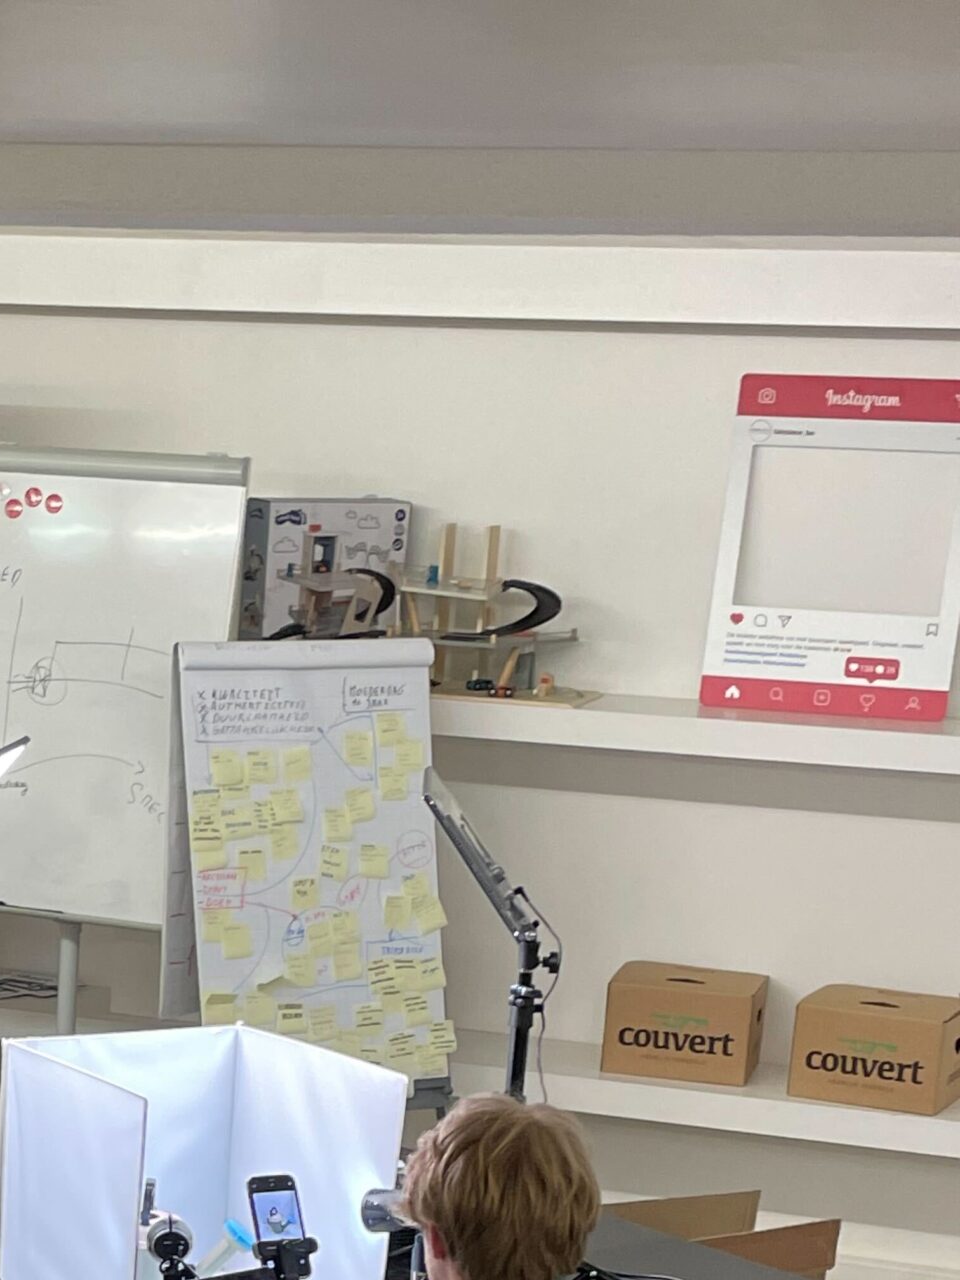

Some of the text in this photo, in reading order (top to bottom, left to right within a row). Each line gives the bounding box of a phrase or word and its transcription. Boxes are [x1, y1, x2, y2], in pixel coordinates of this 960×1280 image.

[825, 389, 901, 413] Instagram
[618, 1027, 735, 1056] couvert
[805, 1050, 925, 1084] couvert
